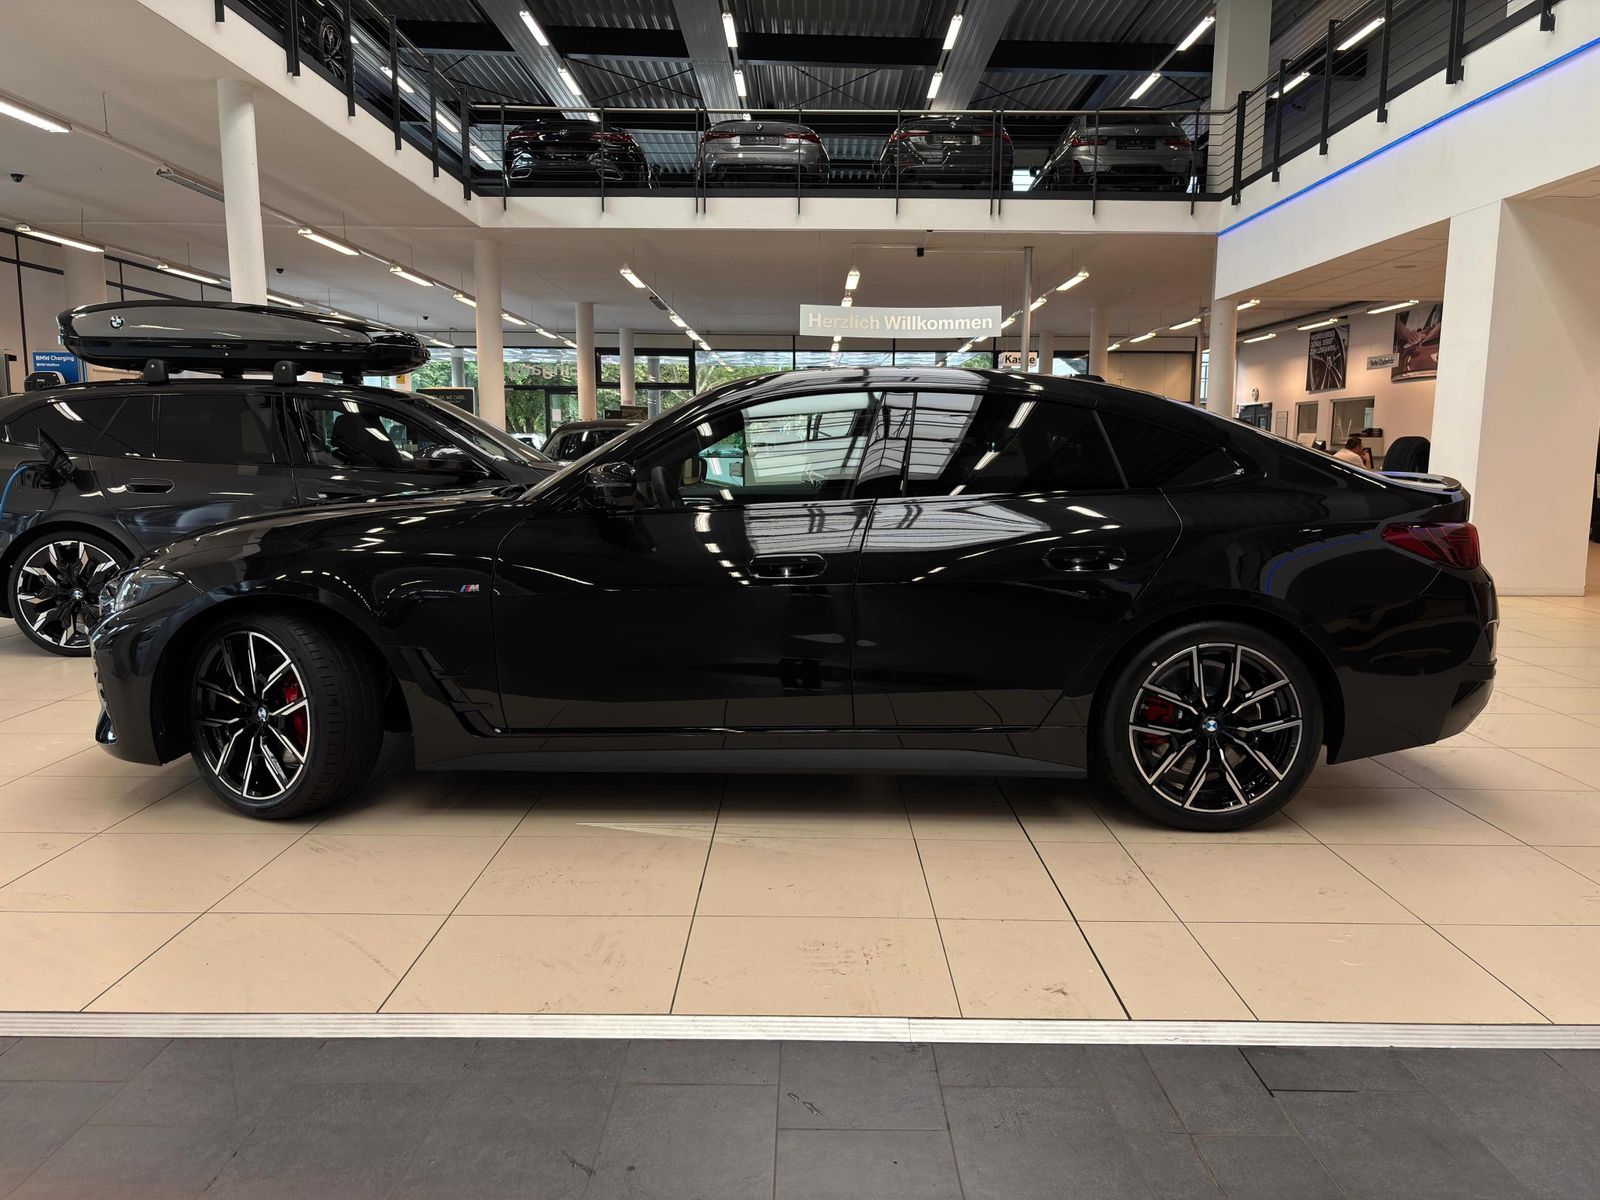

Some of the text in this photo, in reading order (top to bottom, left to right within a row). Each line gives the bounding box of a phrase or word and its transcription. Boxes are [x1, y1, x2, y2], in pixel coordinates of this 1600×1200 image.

[808, 312, 994, 332] Herzlich Willkommen
[1004, 354, 1036, 364] Kase
